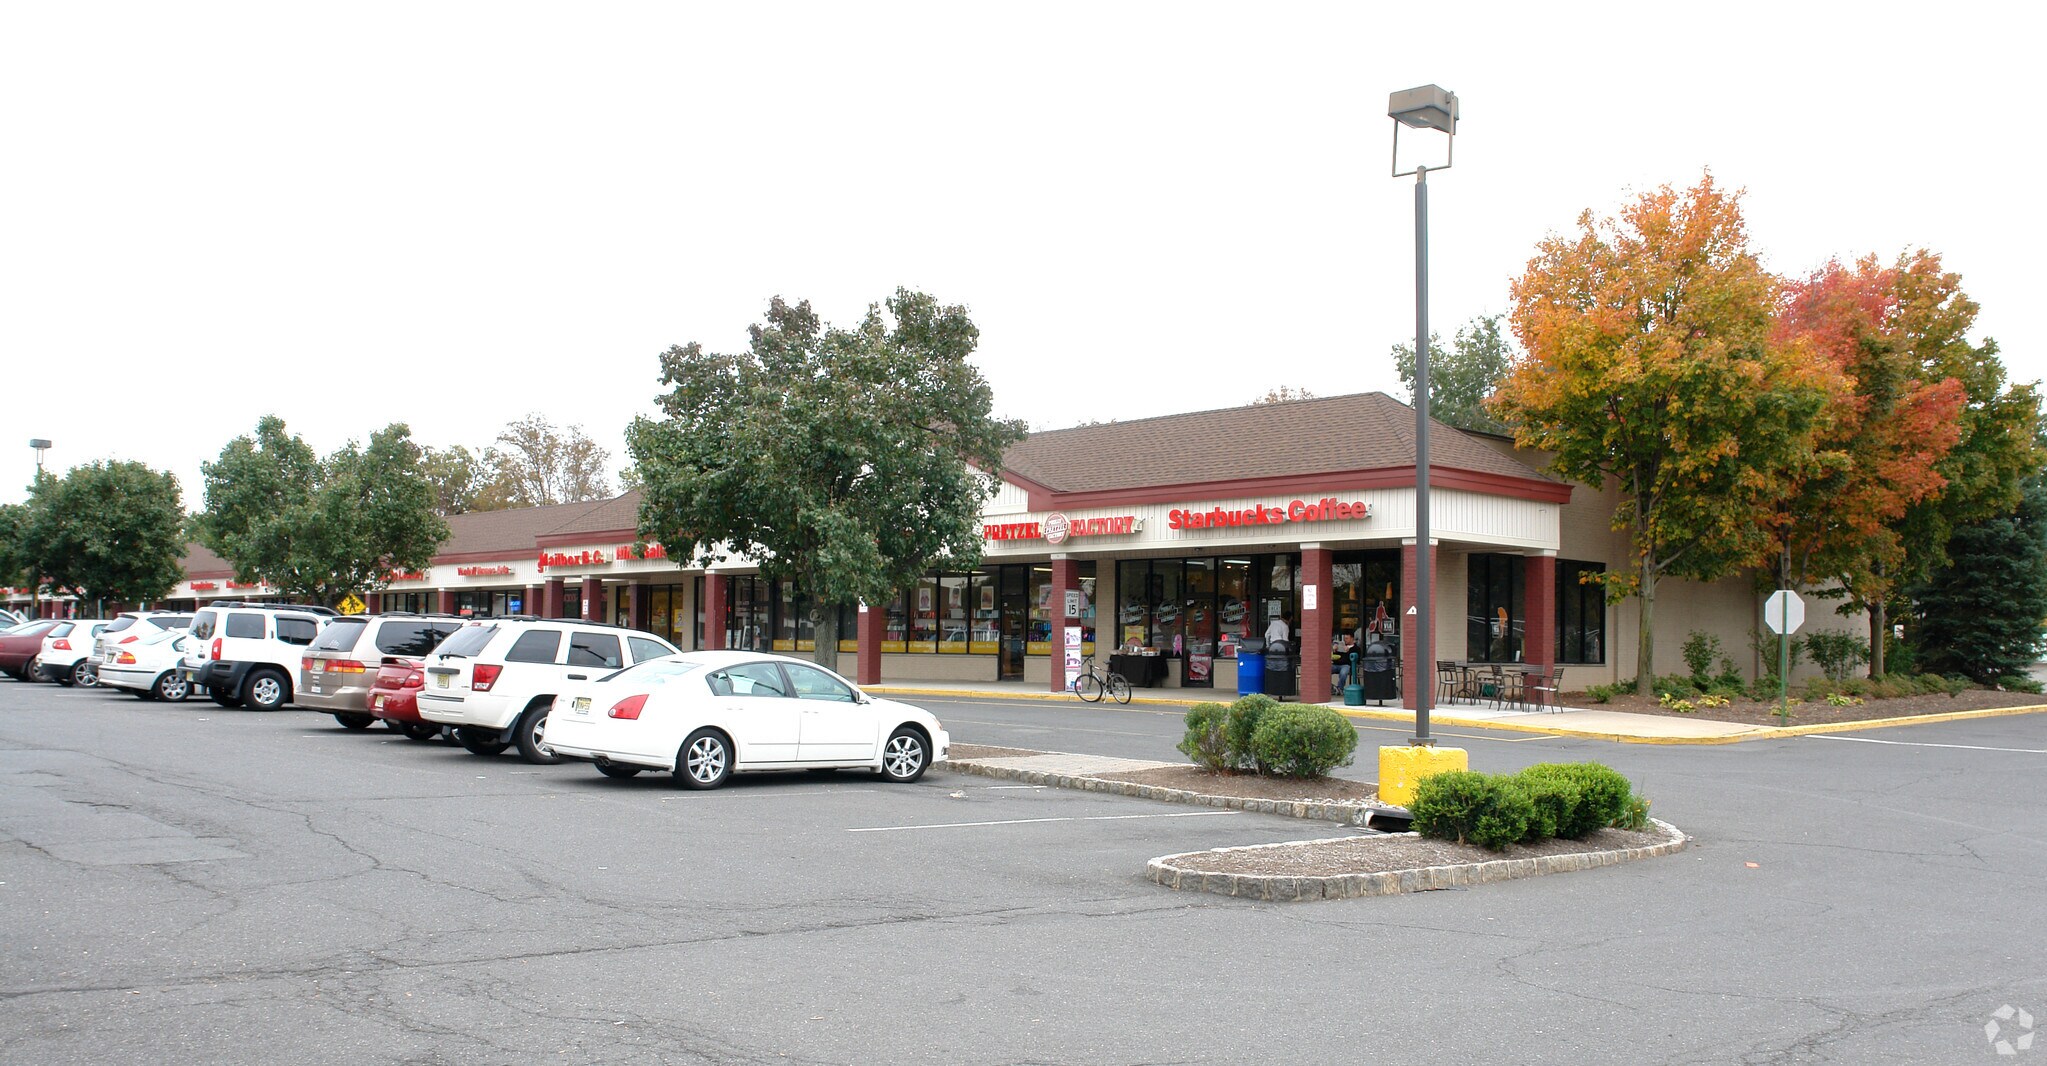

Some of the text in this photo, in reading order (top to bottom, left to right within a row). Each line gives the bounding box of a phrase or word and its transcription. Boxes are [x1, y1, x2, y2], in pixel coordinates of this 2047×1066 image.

[1169, 497, 1367, 530] Starbucks Coffee
[983, 521, 1042, 541] PRETZEL
[1069, 515, 1136, 537] FACTORY
[1068, 604, 1077, 615] 15
